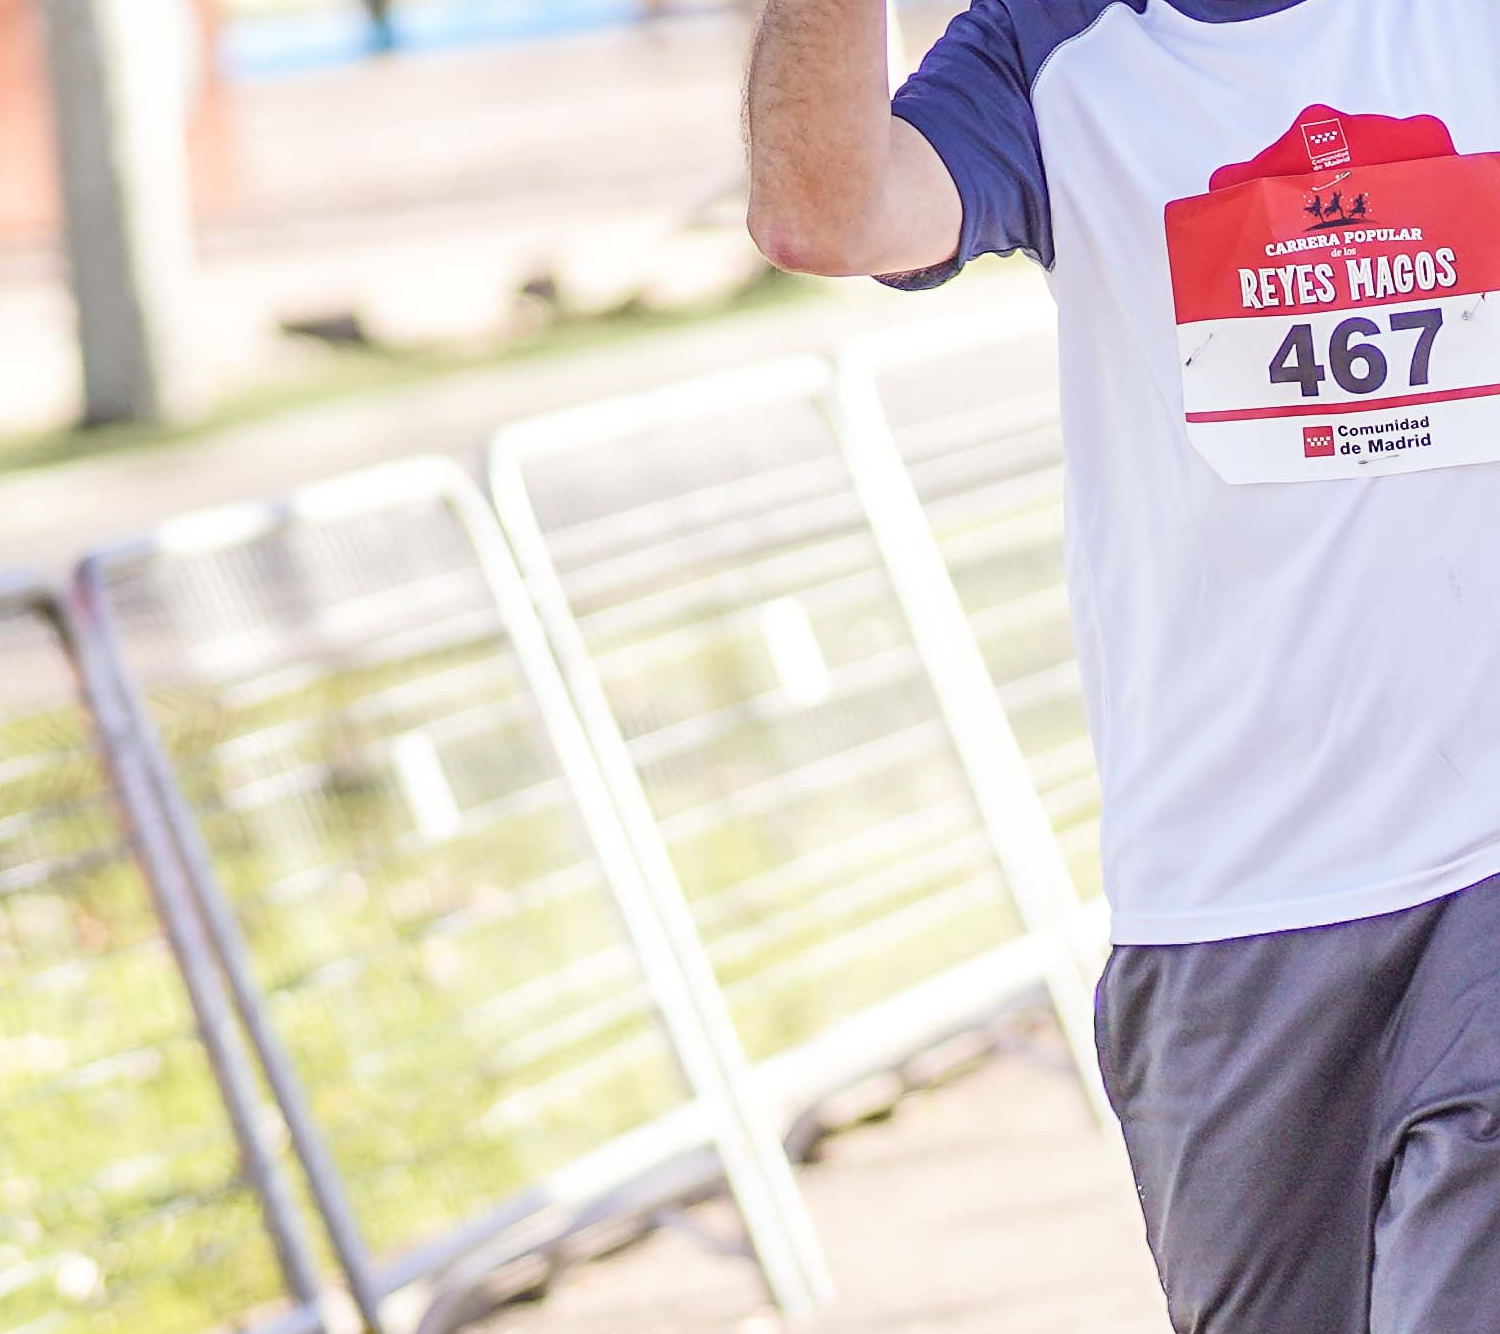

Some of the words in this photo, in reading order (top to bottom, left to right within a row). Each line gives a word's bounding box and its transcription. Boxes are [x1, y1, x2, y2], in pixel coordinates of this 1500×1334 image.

[1265, 233, 1340, 257] CARRERA
[1344, 227, 1423, 244] POPULAR
[1330, 248, 1343, 258] de
[1344, 247, 1357, 256] los
[1238, 263, 1337, 310] REYES
[1345, 247, 1459, 301] MAGOS
[1269, 308, 1443, 397] 467
[1338, 415, 1431, 437] Comunidad
[1340, 442, 1362, 455] de
[1368, 433, 1432, 453] Madrid
